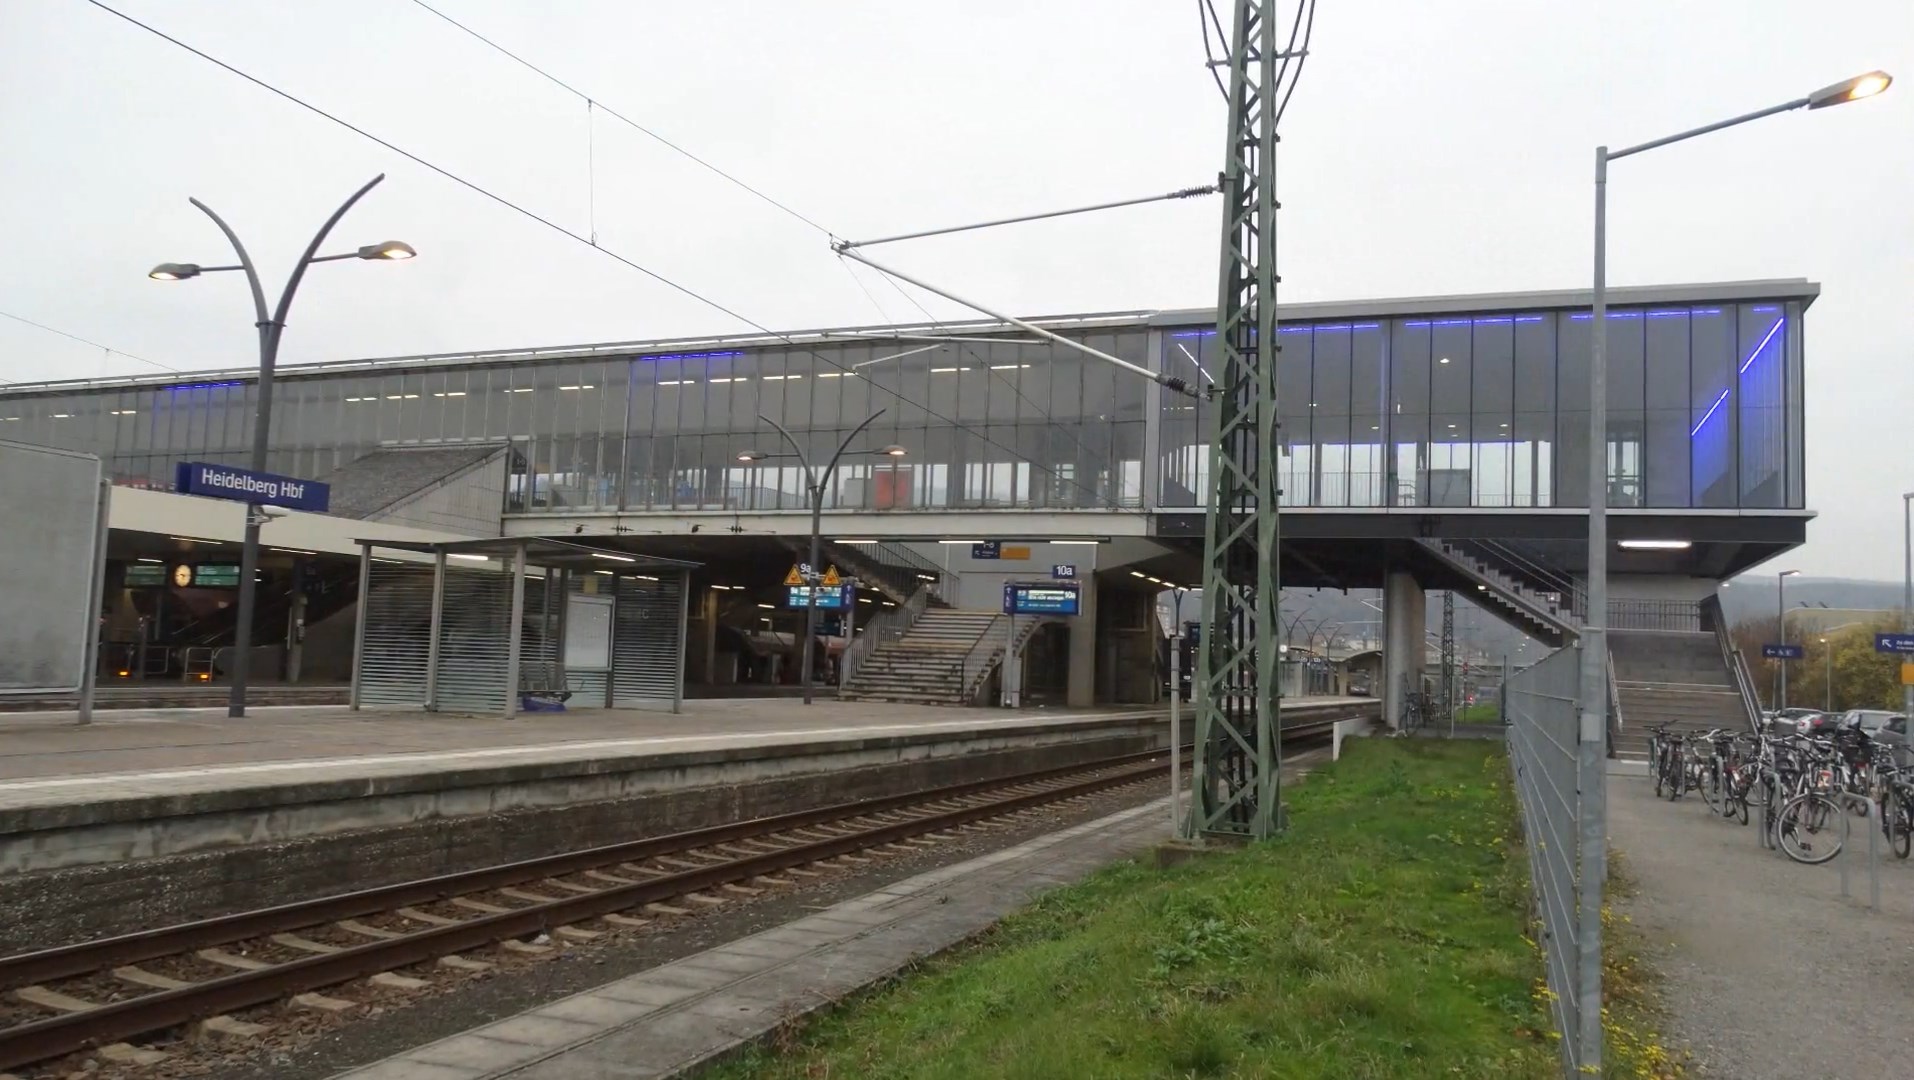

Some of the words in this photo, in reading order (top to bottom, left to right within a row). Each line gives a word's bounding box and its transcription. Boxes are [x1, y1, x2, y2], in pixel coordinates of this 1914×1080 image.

[202, 468, 277, 498] Heidelberg
[281, 481, 304, 499] Hbf
[800, 563, 811, 573] 9a
[1056, 565, 1073, 576] 10a
